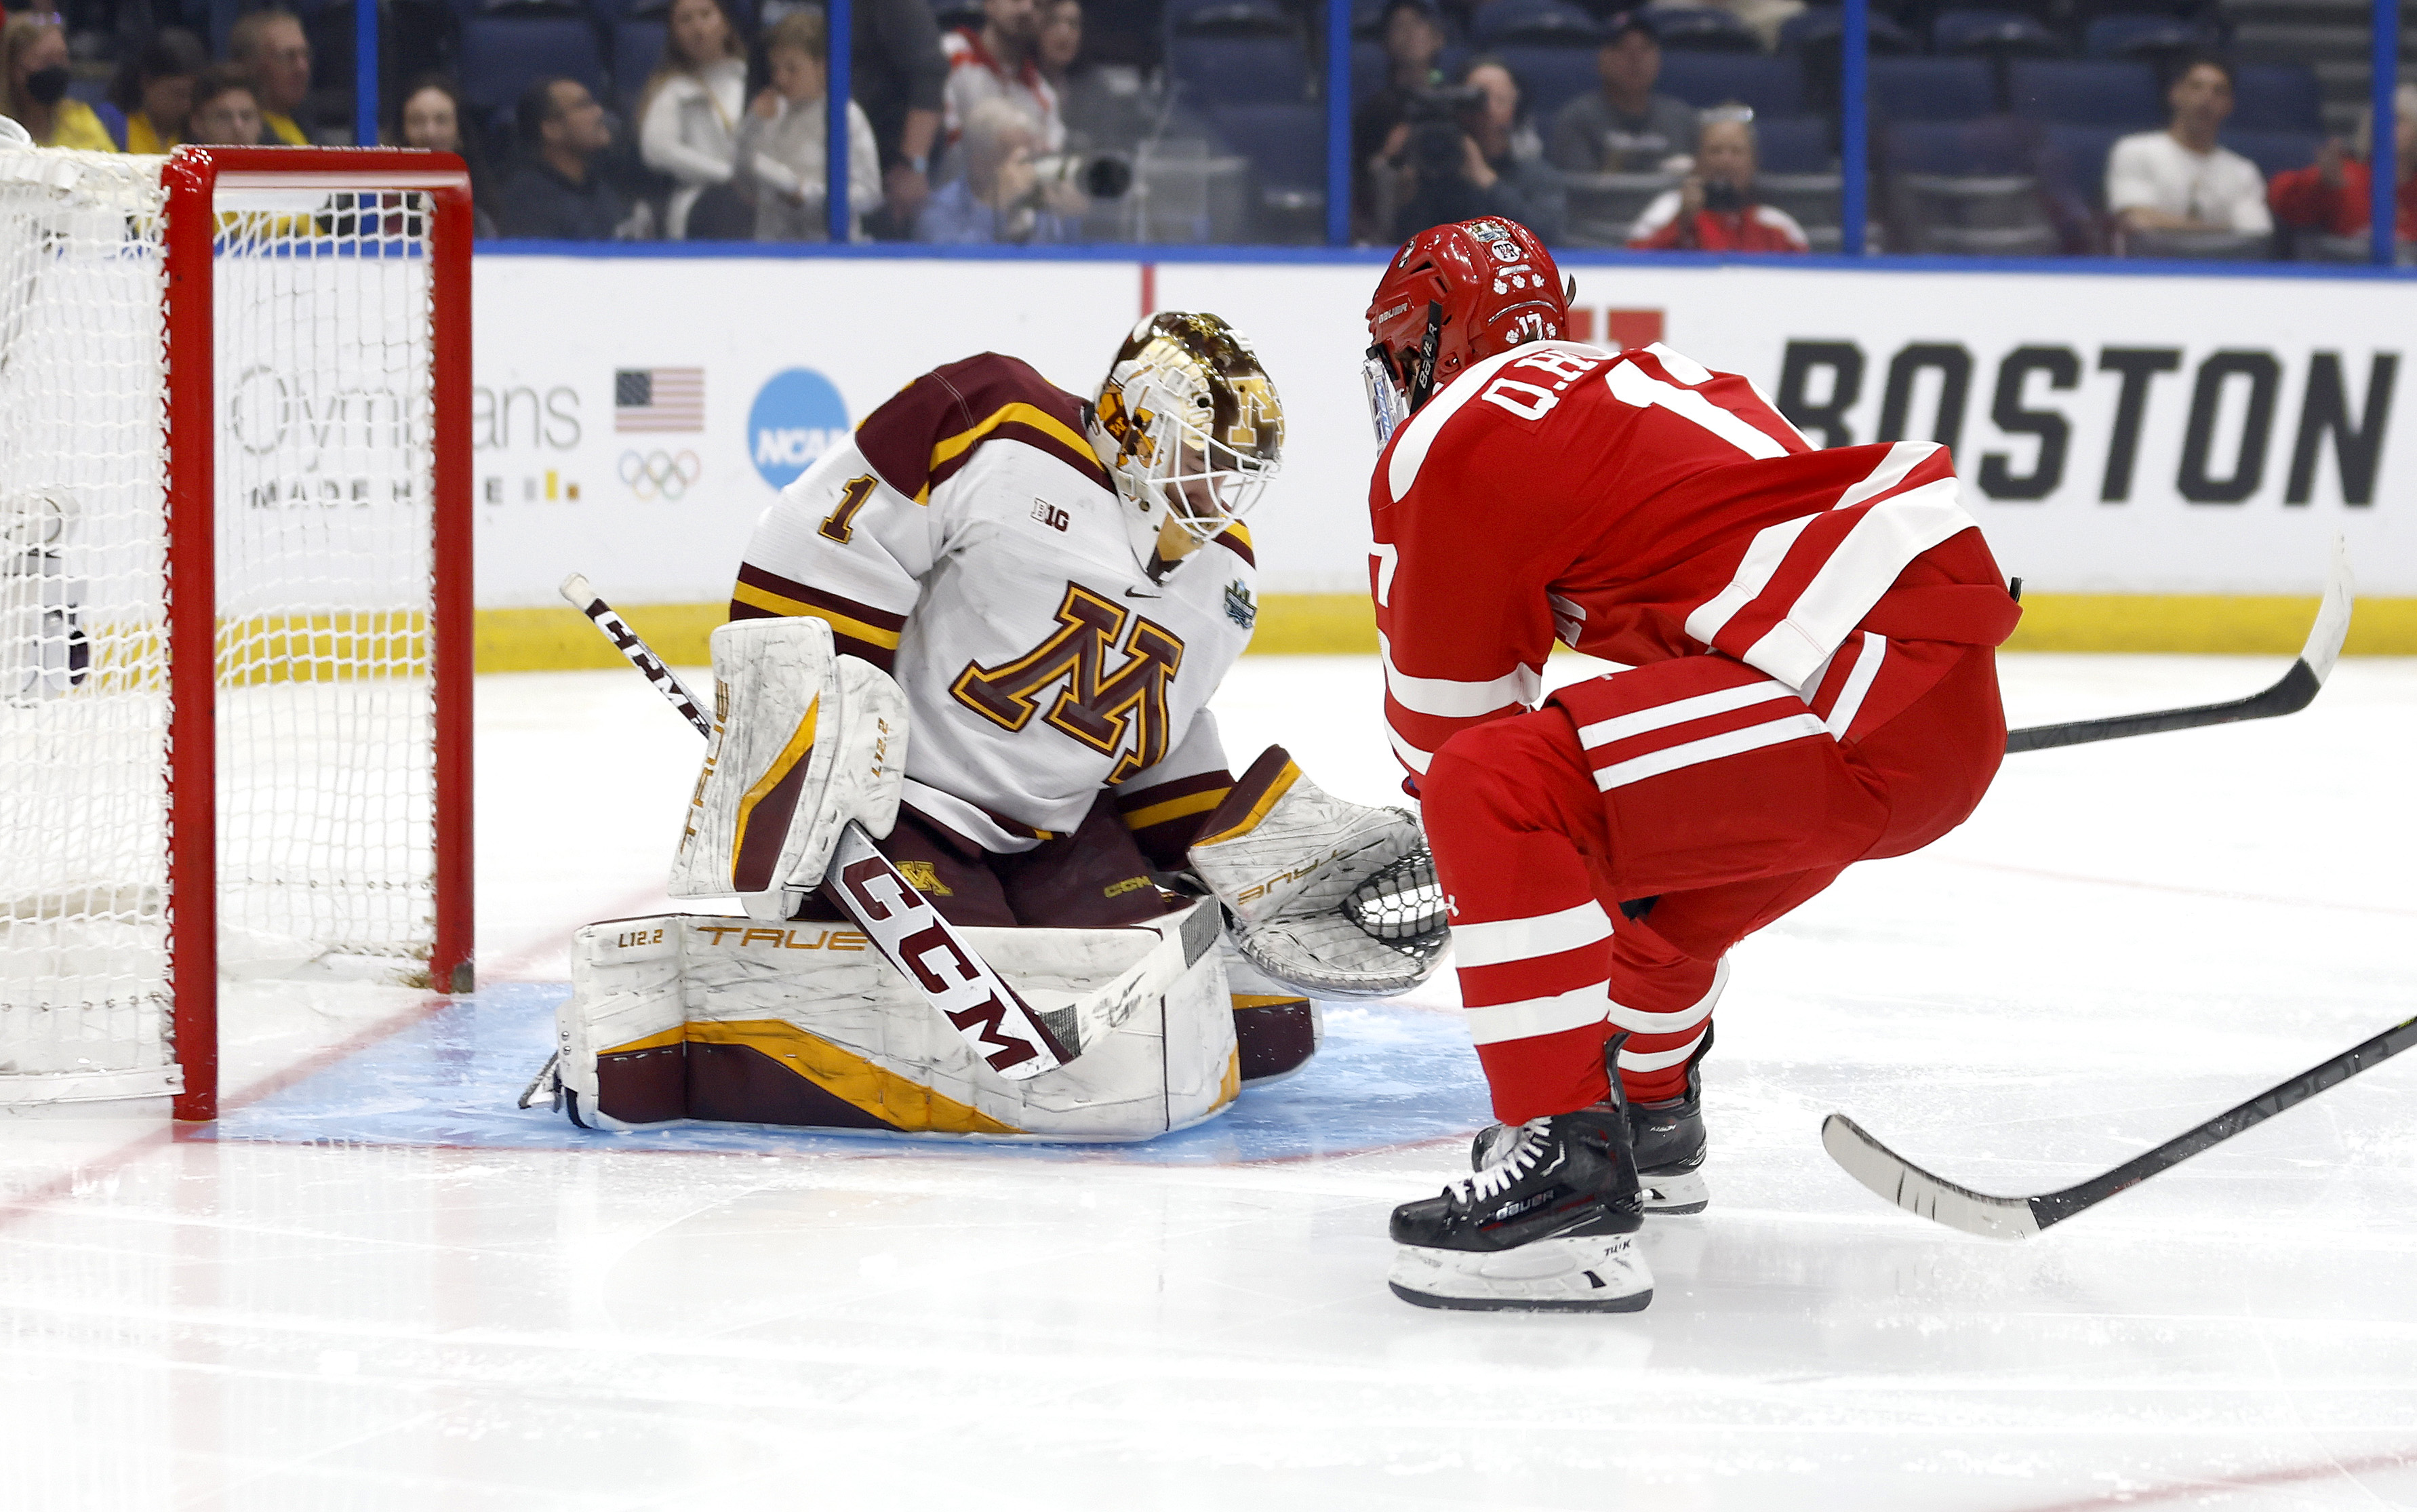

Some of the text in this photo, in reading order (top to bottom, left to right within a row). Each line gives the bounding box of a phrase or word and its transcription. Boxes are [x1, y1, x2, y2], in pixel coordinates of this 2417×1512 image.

[231, 364, 581, 474] Olympans
[1481, 349, 1599, 421] Q.H
[1778, 338, 2399, 508] BOSTON
[818, 473, 878, 545] 1
[949, 580, 1185, 787] M
[680, 678, 730, 854] TRUE
[618, 928, 664, 948] L12.2
[696, 926, 870, 951] TRUE
[842, 856, 1039, 1072] CCM
